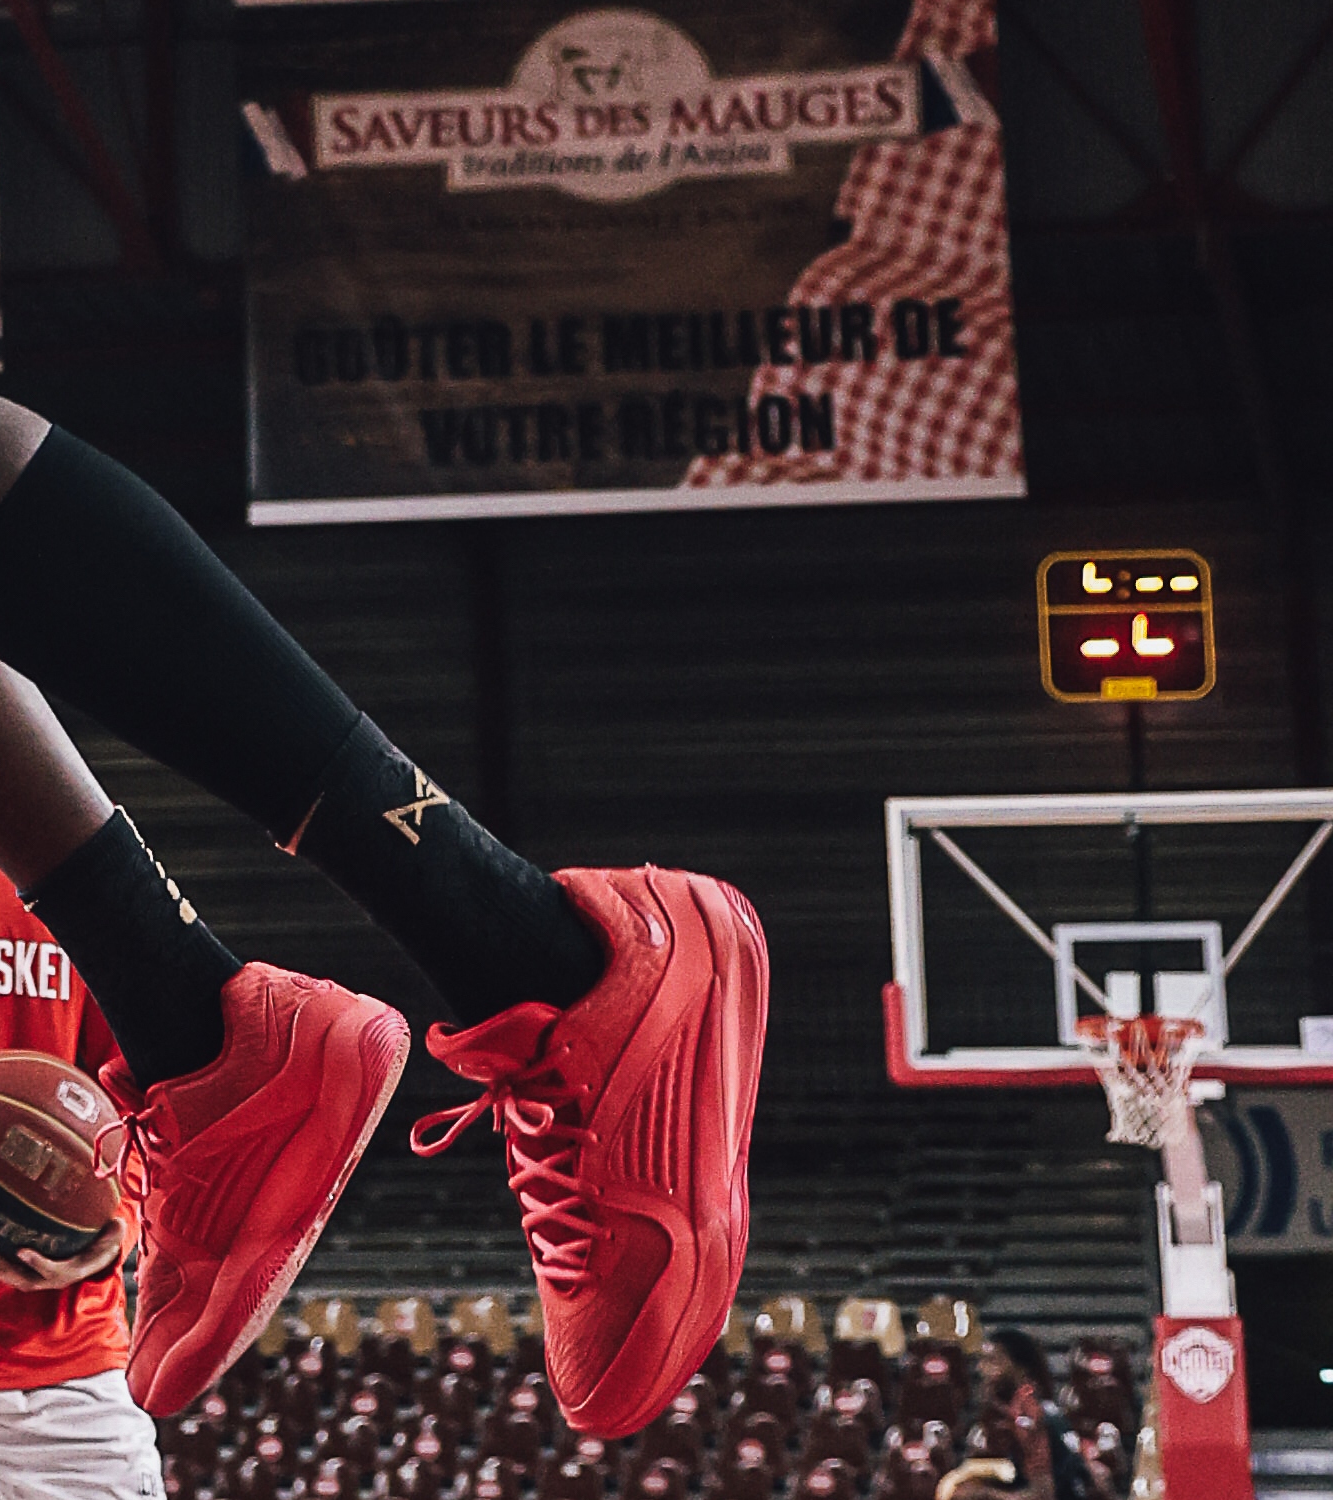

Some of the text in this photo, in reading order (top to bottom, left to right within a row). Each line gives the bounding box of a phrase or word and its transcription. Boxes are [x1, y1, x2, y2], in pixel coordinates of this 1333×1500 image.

[332, 76, 905, 154] SAVEURS DES MAUGES
[530, 313, 587, 375] LE
[602, 300, 876, 372] MEILLEUR
[893, 296, 966, 359] DE
[420, 401, 609, 467] VOTRE
